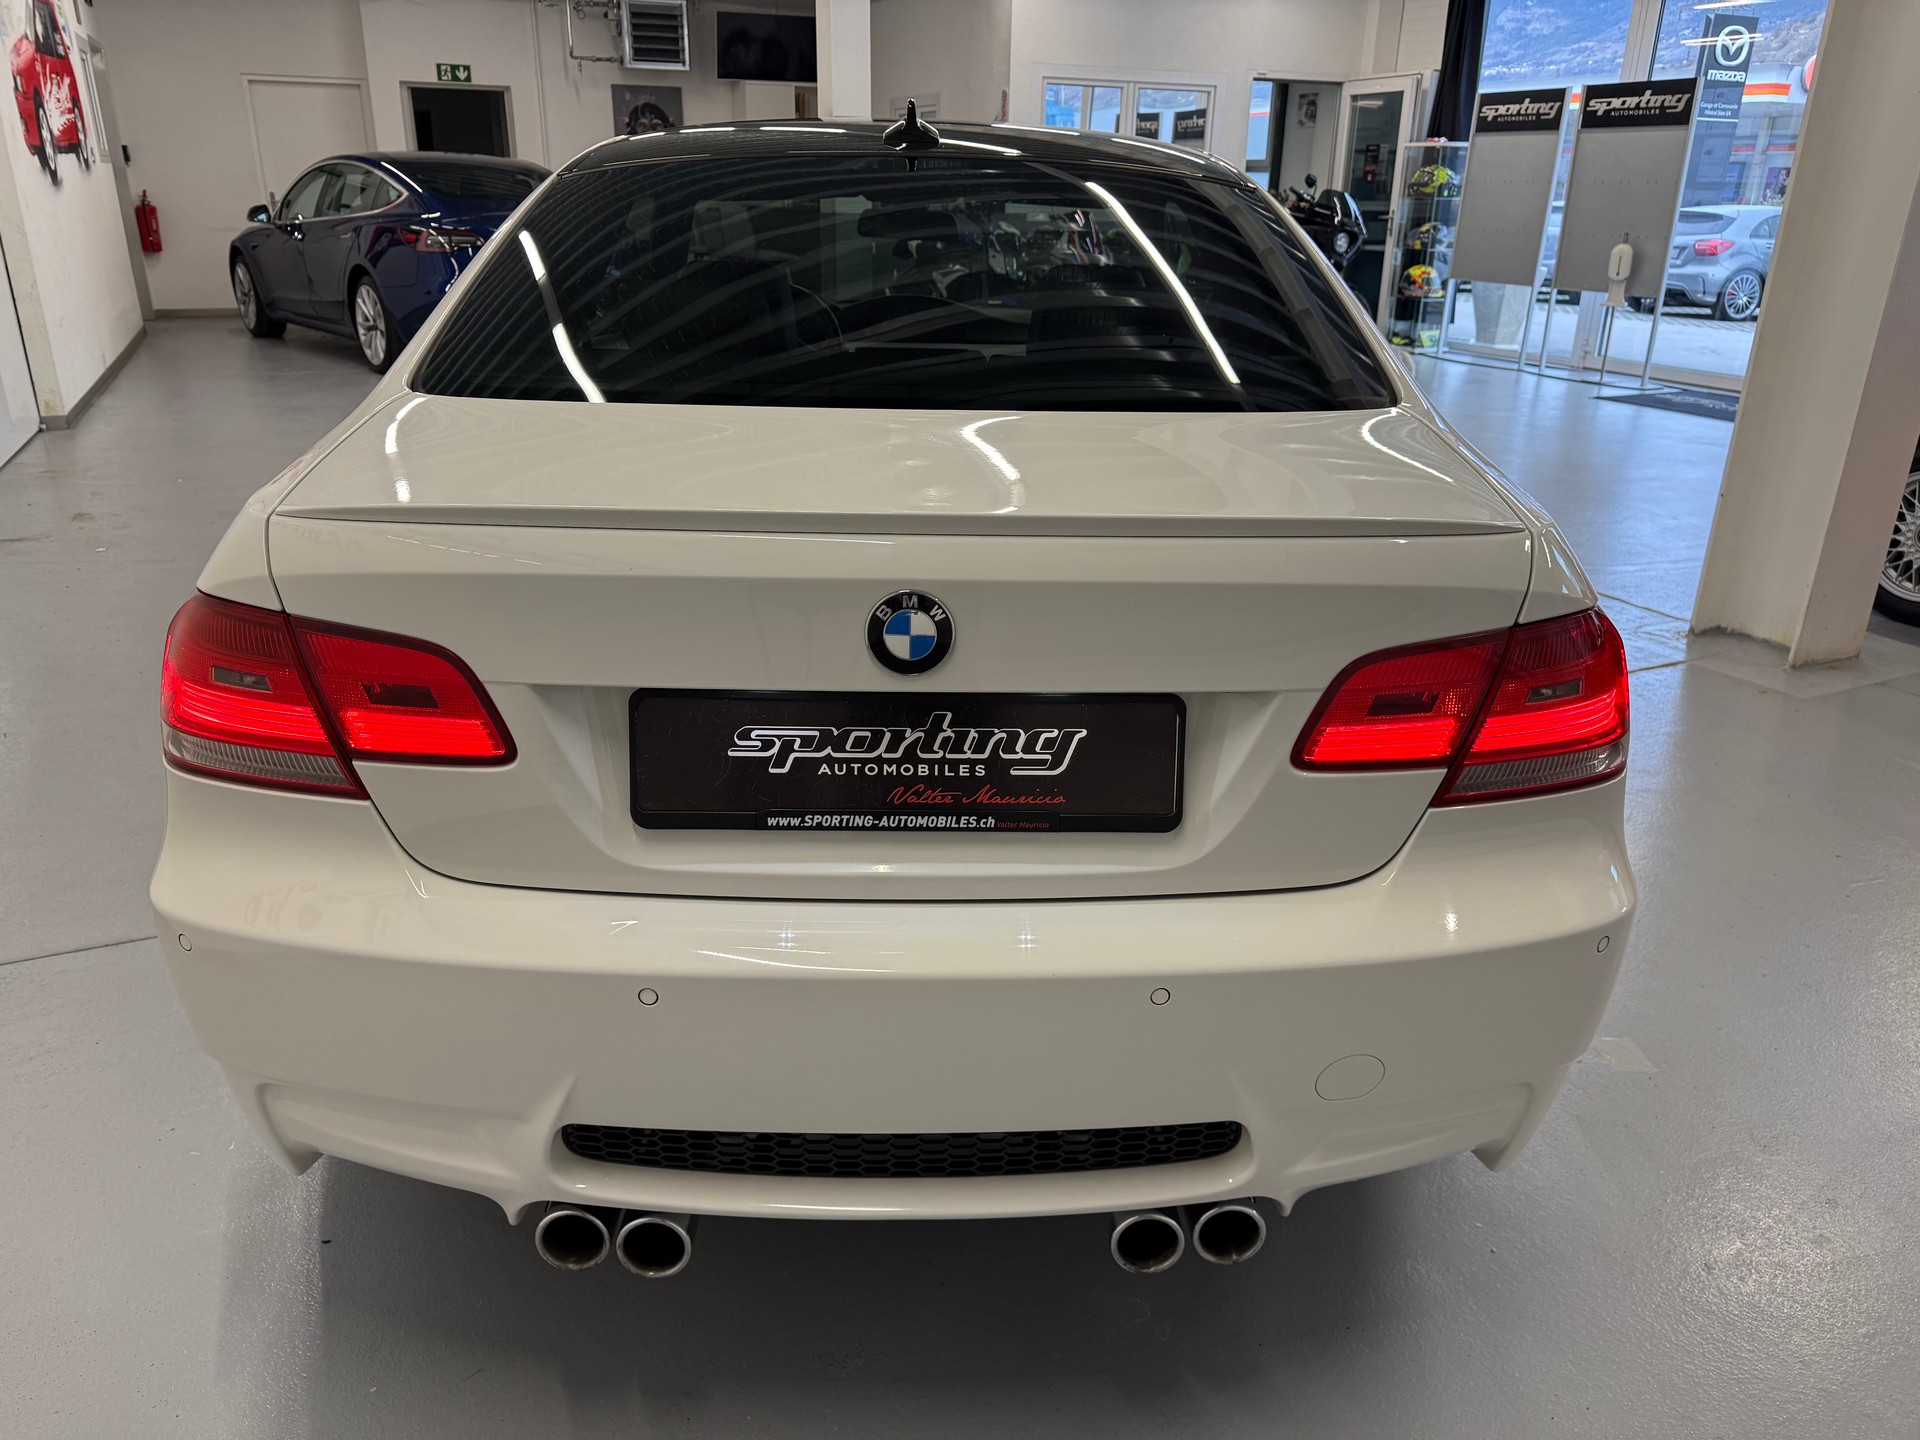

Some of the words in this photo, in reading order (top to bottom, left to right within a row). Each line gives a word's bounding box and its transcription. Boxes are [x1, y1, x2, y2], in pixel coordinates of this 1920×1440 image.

[1479, 97, 1562, 121] sporting
[1586, 89, 1691, 117] sporting
[1610, 108, 1659, 117] AUTOMOBILES
[1497, 114, 1536, 122] AUTOMOBILES
[876, 594, 947, 622] BMW
[727, 711, 1088, 776] sporting
[817, 763, 987, 777] AUTOMOBILES
[886, 784, 963, 805] Valter
[963, 784, 1066, 805] Mauricio
[767, 814, 995, 829] www.SPORTING-AUTOMOBILES.ch
